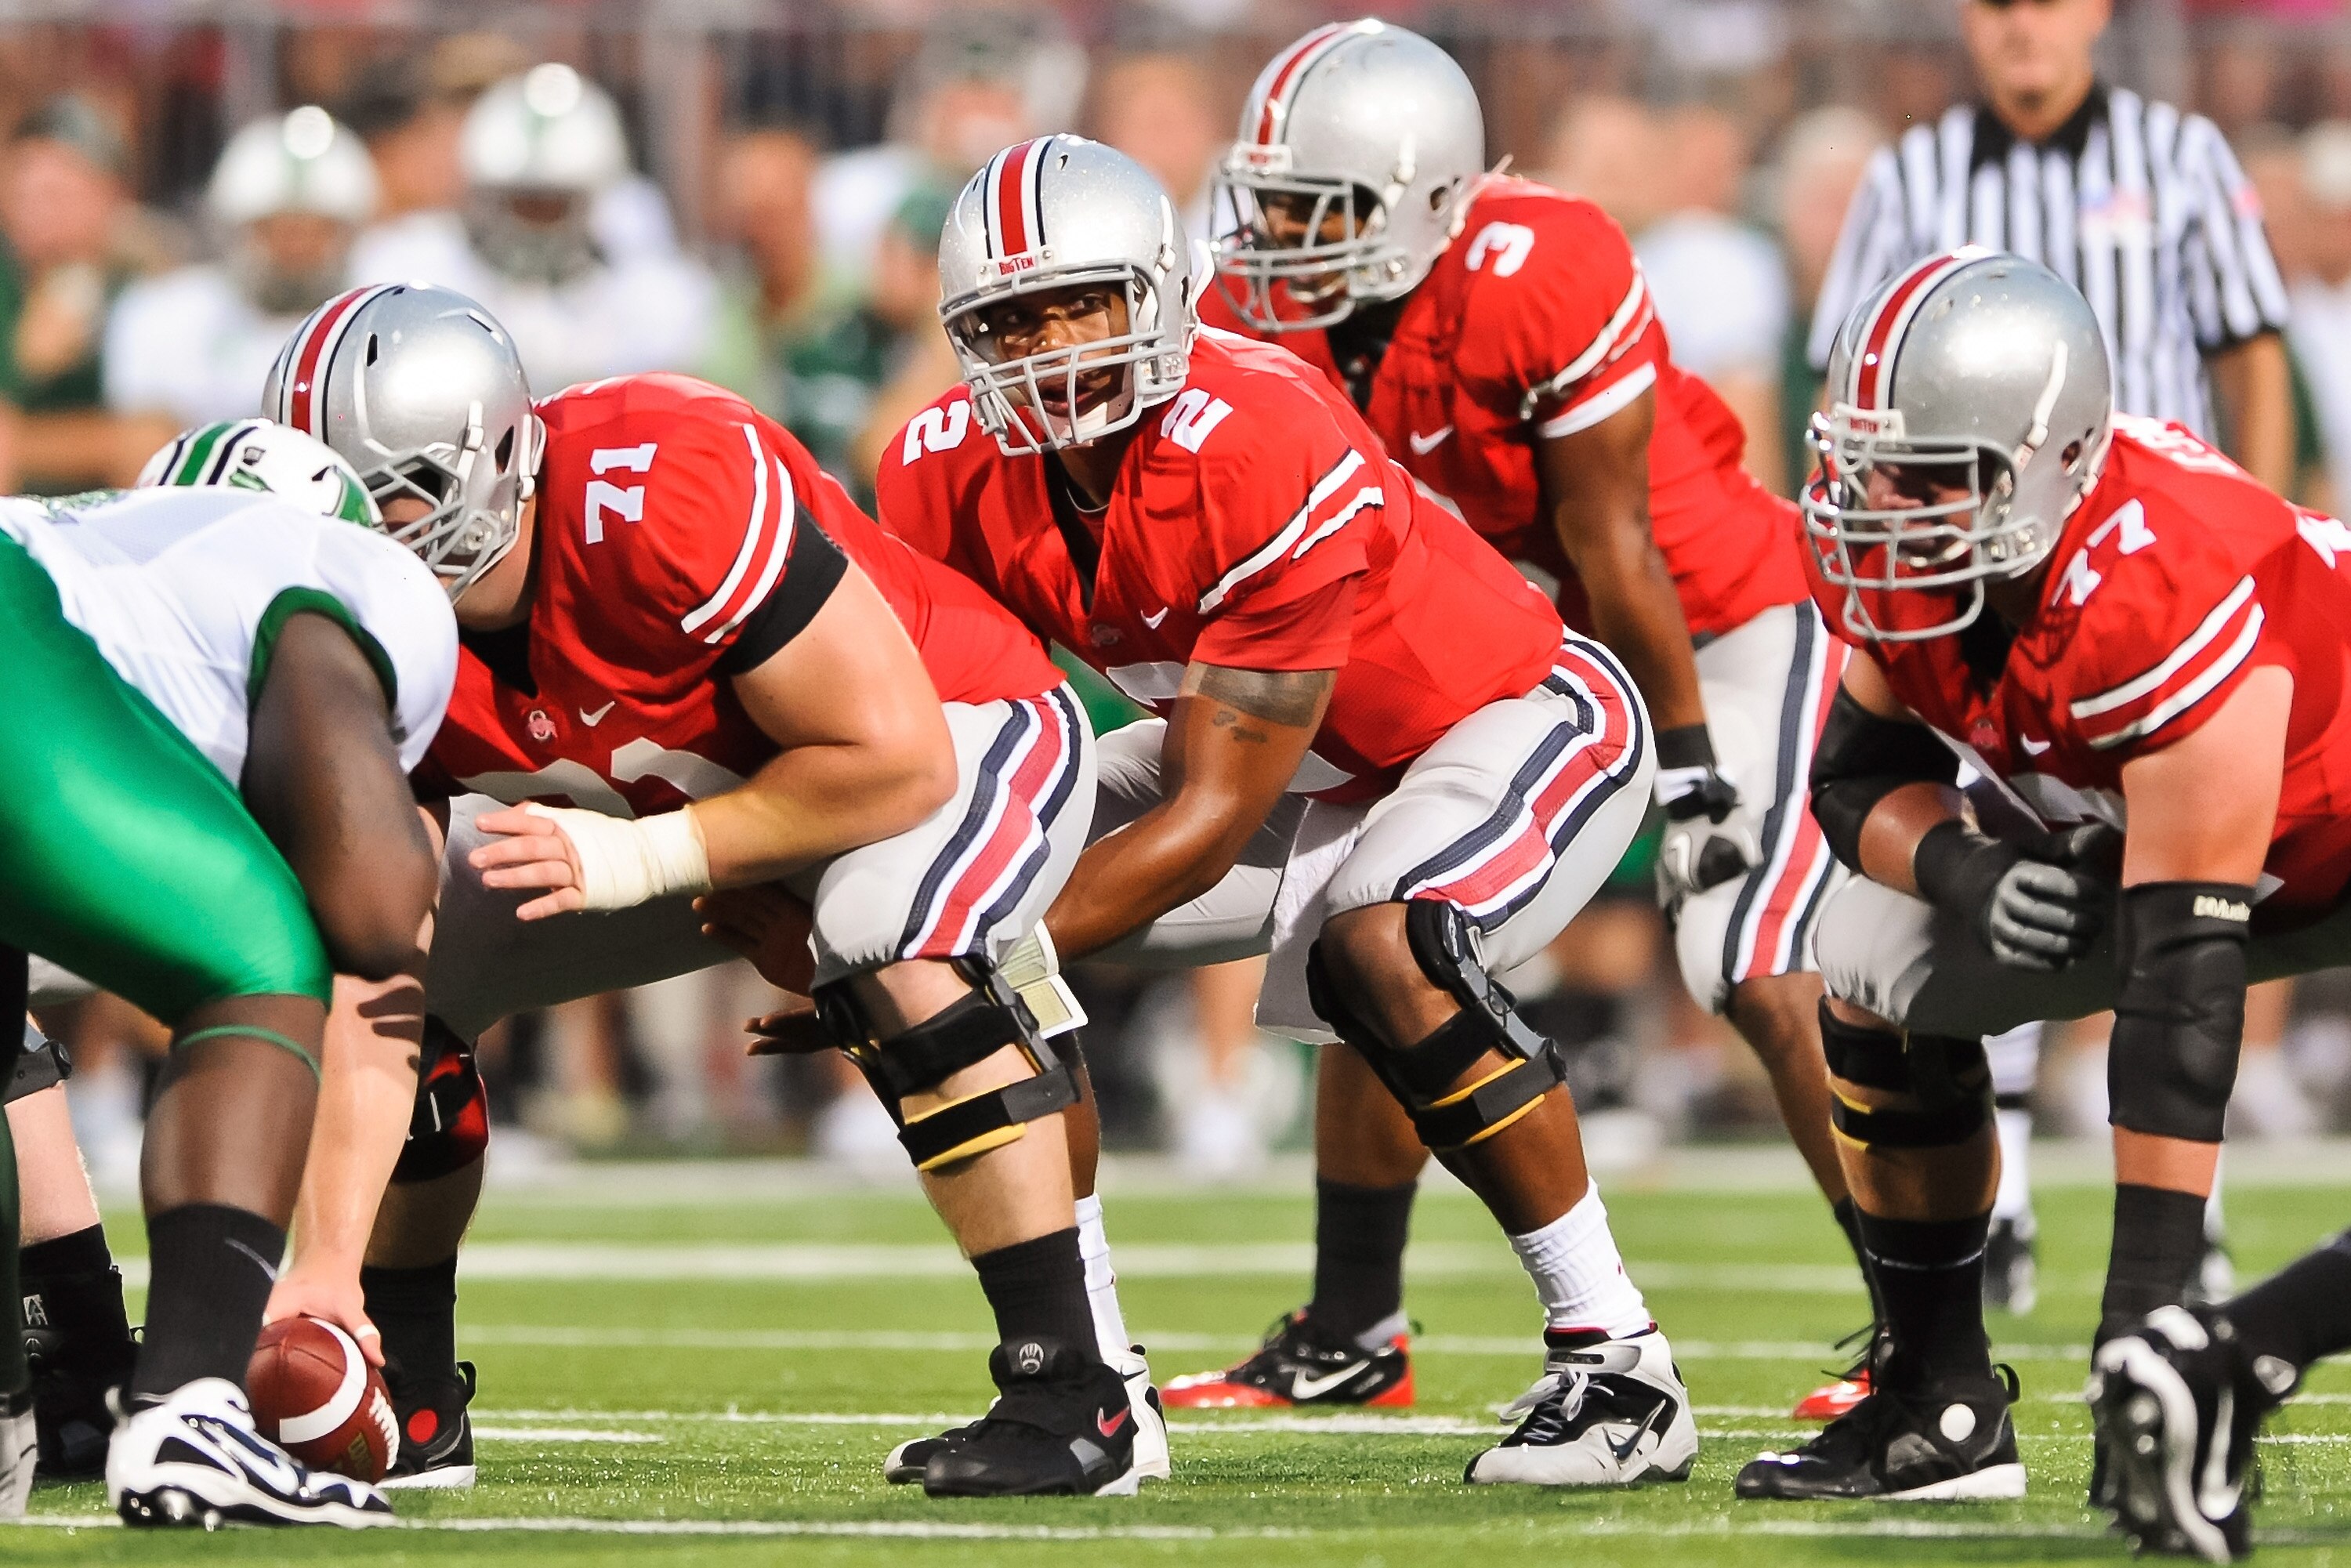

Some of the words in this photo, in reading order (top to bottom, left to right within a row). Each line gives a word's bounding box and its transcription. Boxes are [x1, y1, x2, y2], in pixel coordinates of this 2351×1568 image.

[1466, 221, 1534, 277] 3
[903, 399, 972, 466] 2
[1160, 387, 1233, 454] 2
[585, 443, 658, 545] 71
[2050, 498, 2157, 606] 77
